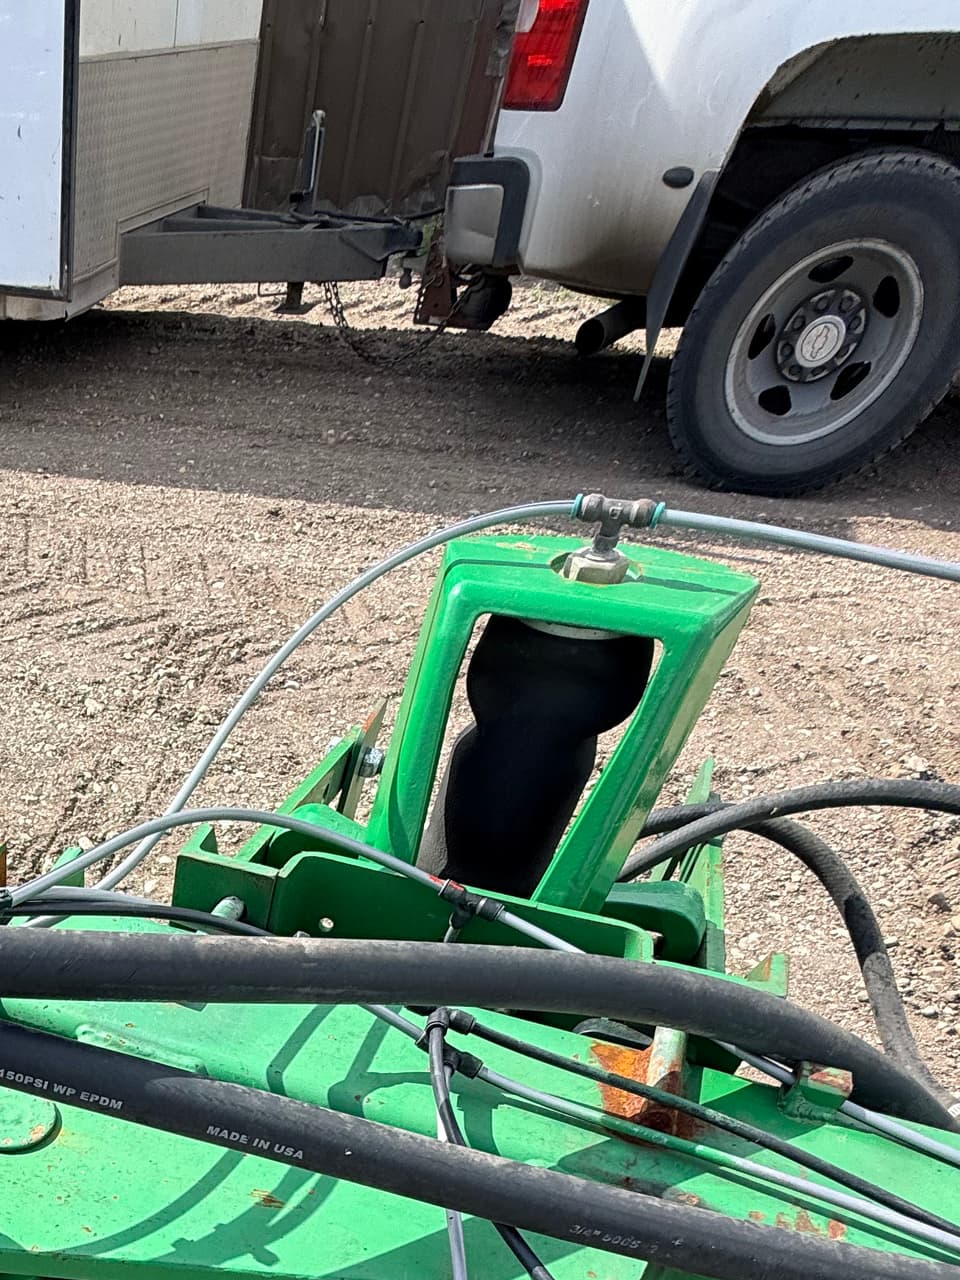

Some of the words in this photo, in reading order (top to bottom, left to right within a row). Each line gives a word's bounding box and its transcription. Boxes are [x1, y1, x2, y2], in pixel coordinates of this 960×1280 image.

[53, 1083, 77, 1098] WP
[79, 1091, 124, 1111] EPDM
[206, 1125, 249, 1145] MADE
[252, 1137, 271, 1151] IN
[274, 1144, 305, 1160] USA
